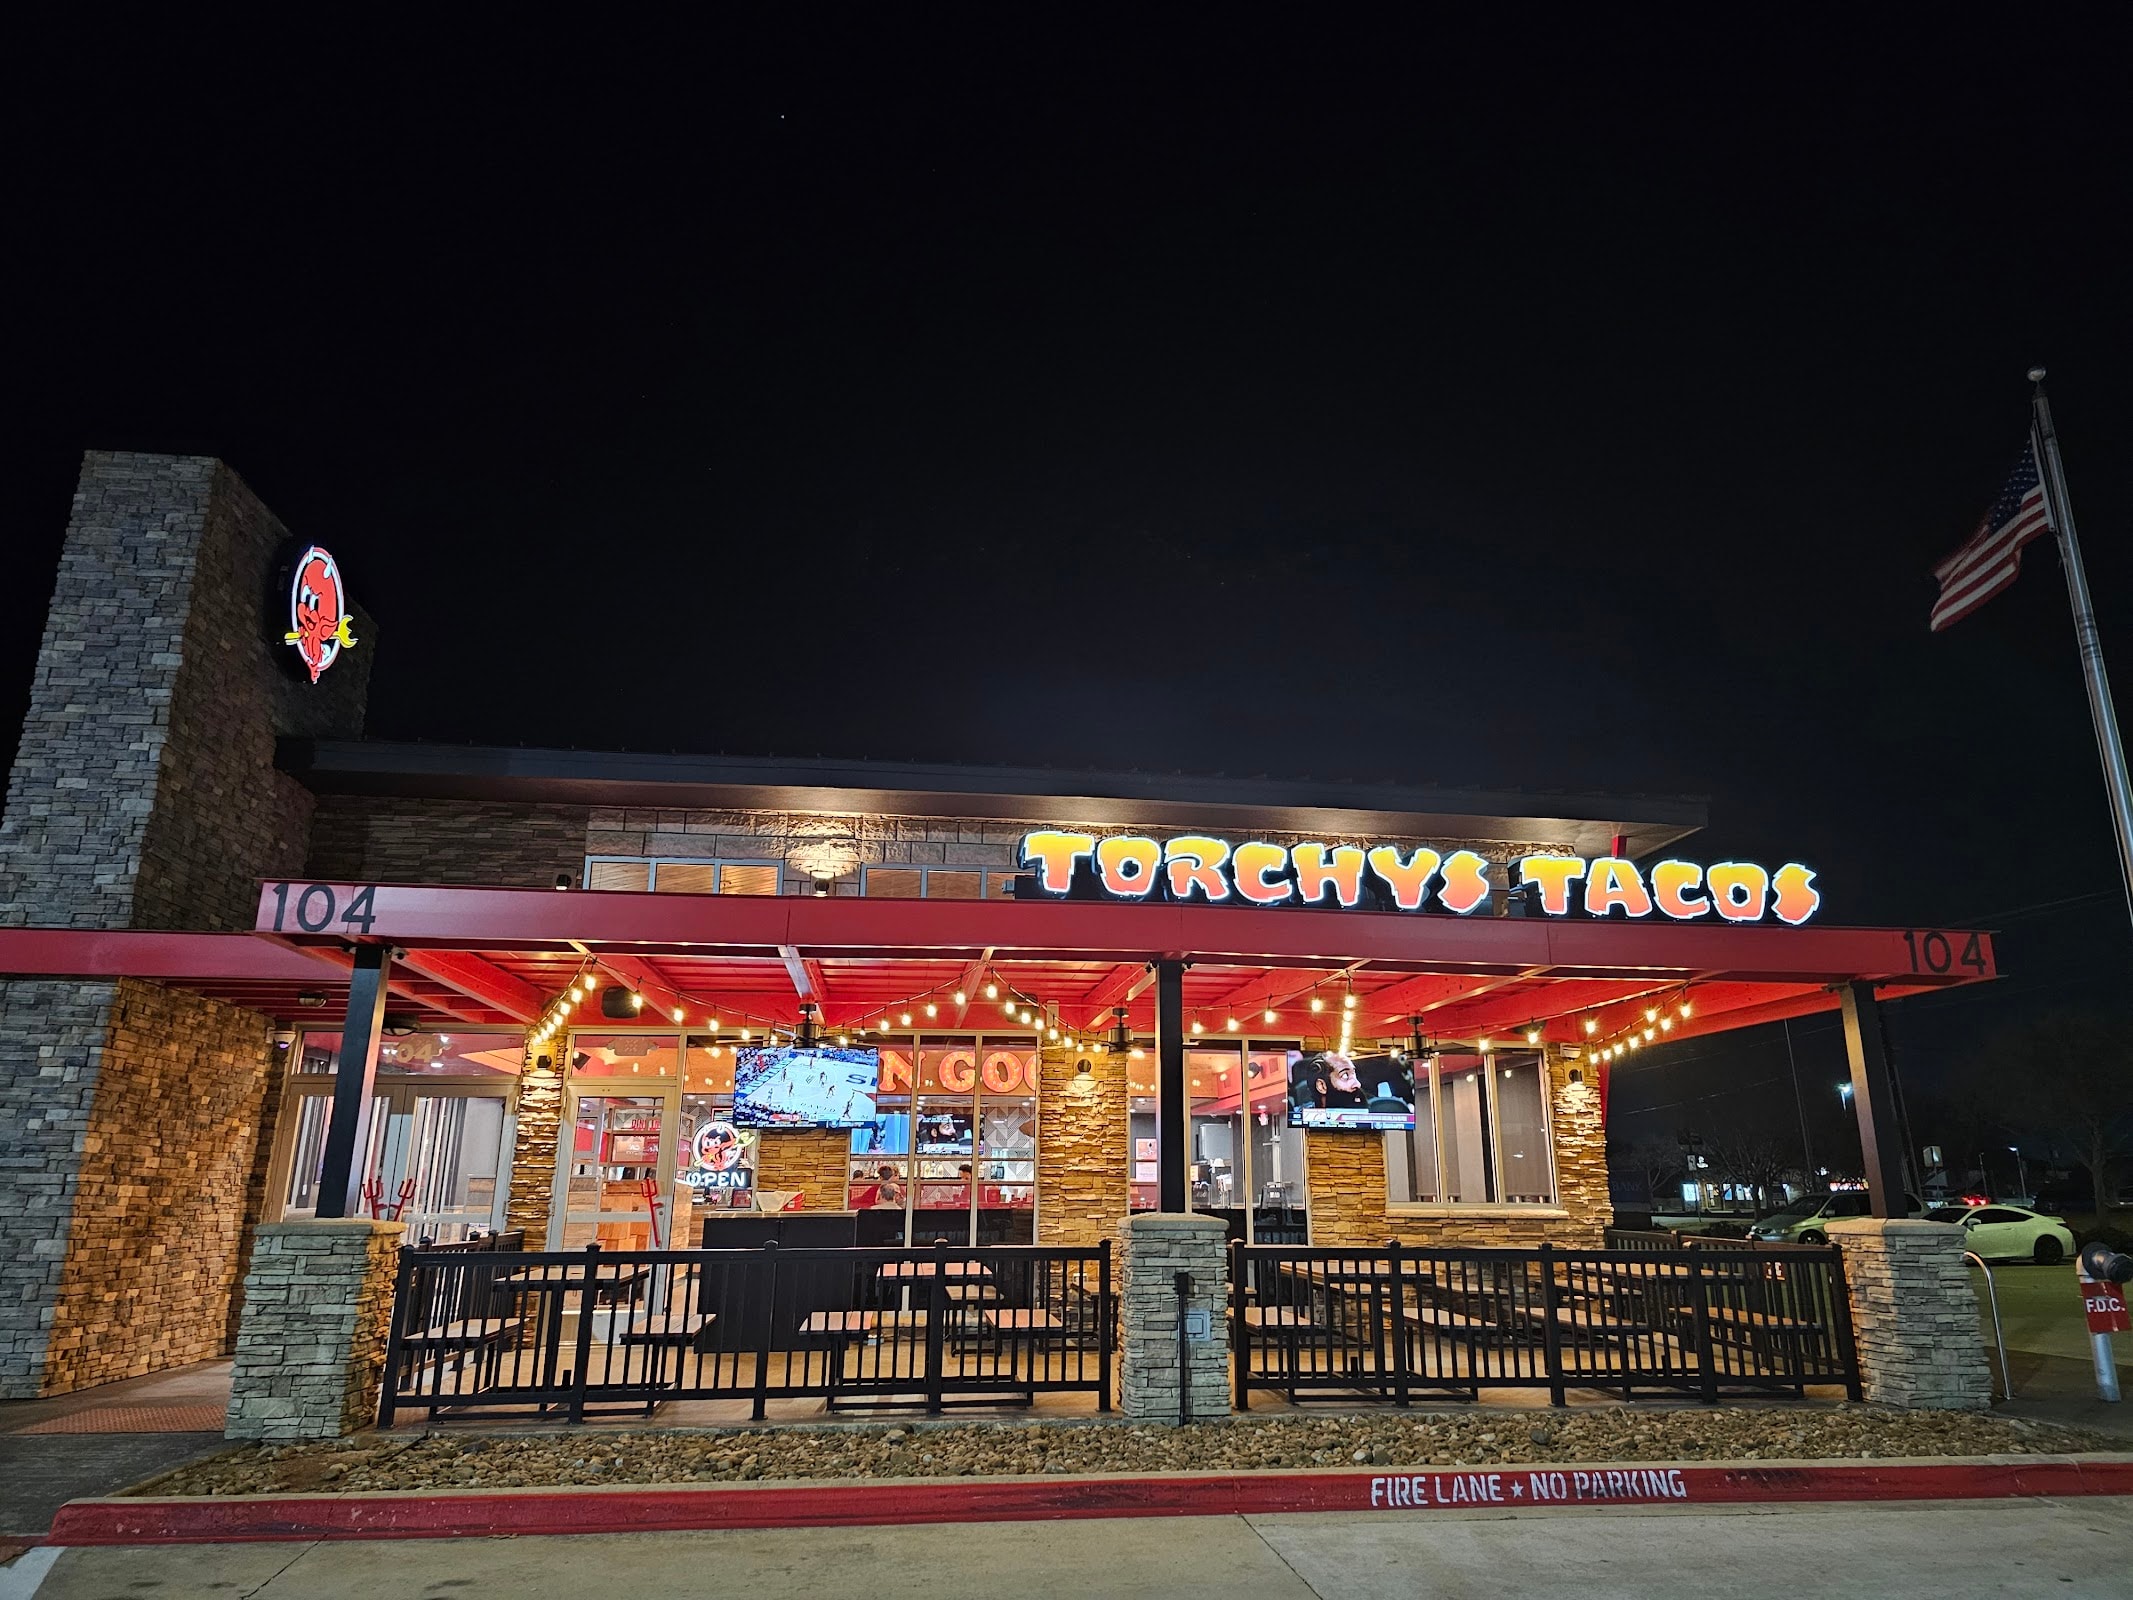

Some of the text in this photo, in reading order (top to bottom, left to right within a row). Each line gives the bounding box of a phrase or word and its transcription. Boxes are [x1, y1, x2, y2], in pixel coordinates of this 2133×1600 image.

[1021, 831, 1820, 925] TORCHYS TACOS
[272, 882, 376, 934] 104
[1903, 930, 1987, 976] 104
[685, 1171, 746, 1187] OPEN
[1371, 1469, 1687, 1507] FIRE LANE NO PARKING
